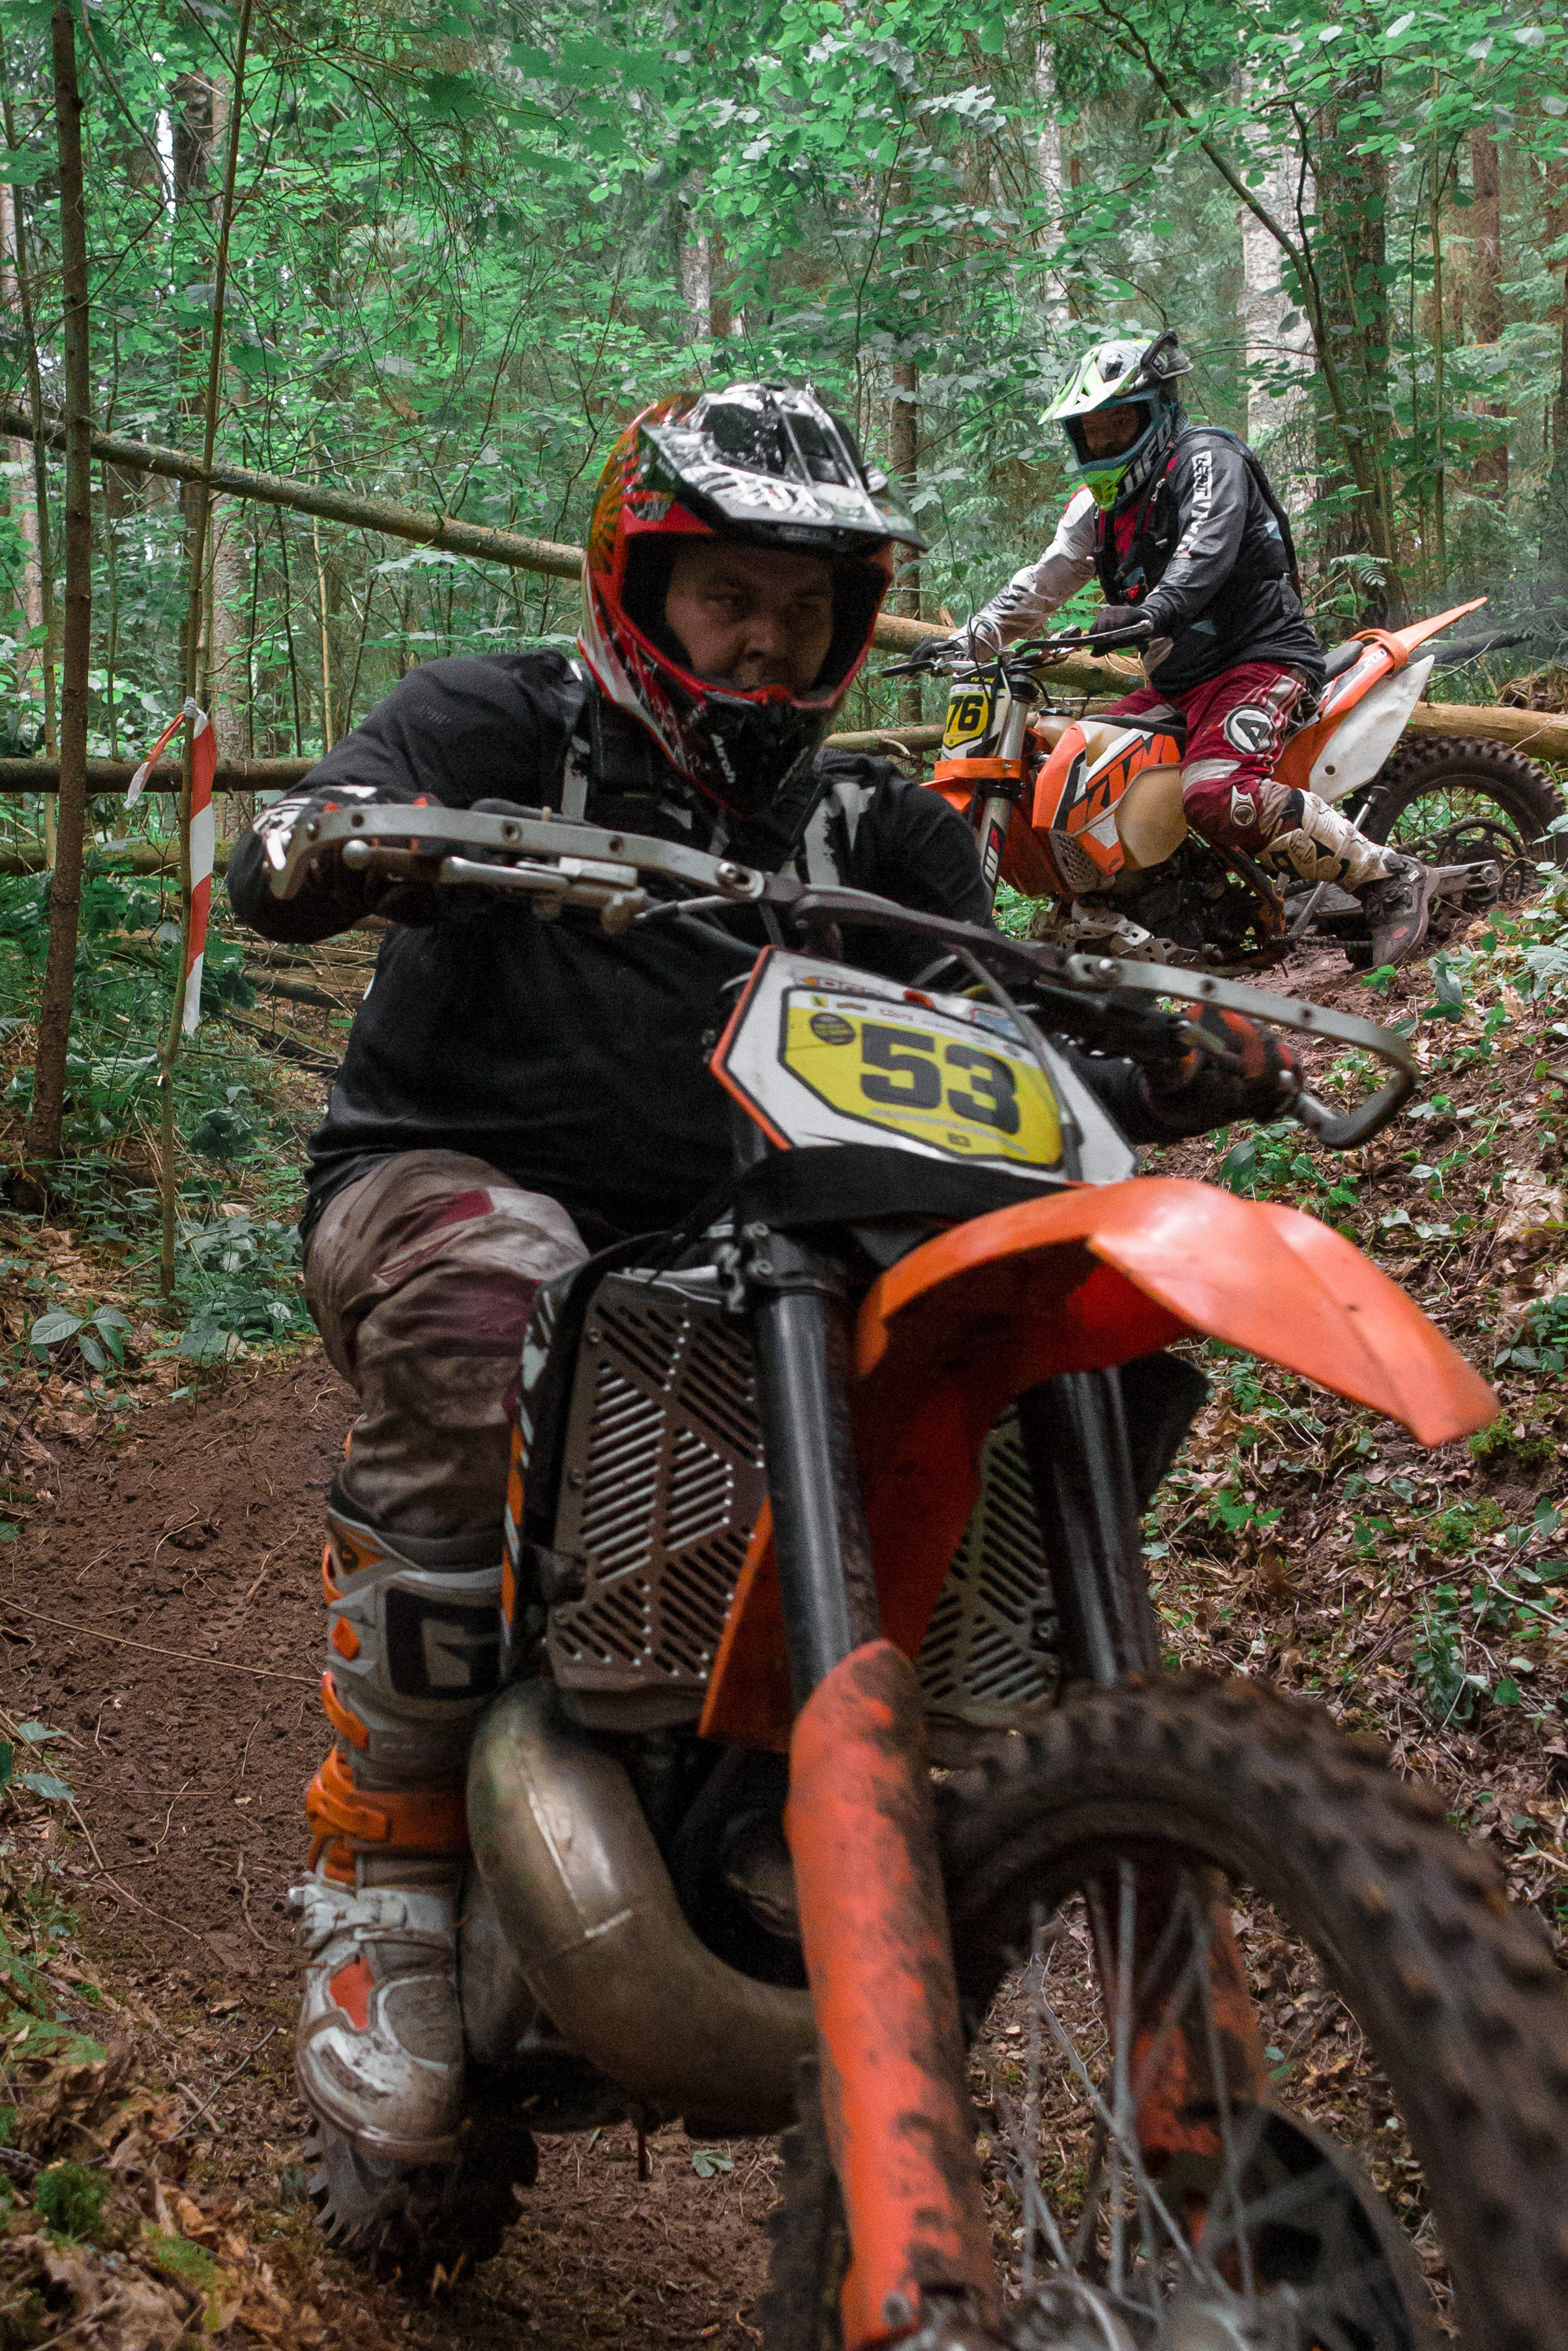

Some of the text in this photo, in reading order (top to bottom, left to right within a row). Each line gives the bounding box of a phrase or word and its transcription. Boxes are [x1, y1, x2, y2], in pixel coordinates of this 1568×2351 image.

[946, 695, 984, 732] 76
[1066, 733, 1181, 834] KTM
[860, 1022, 1020, 1134] 53
